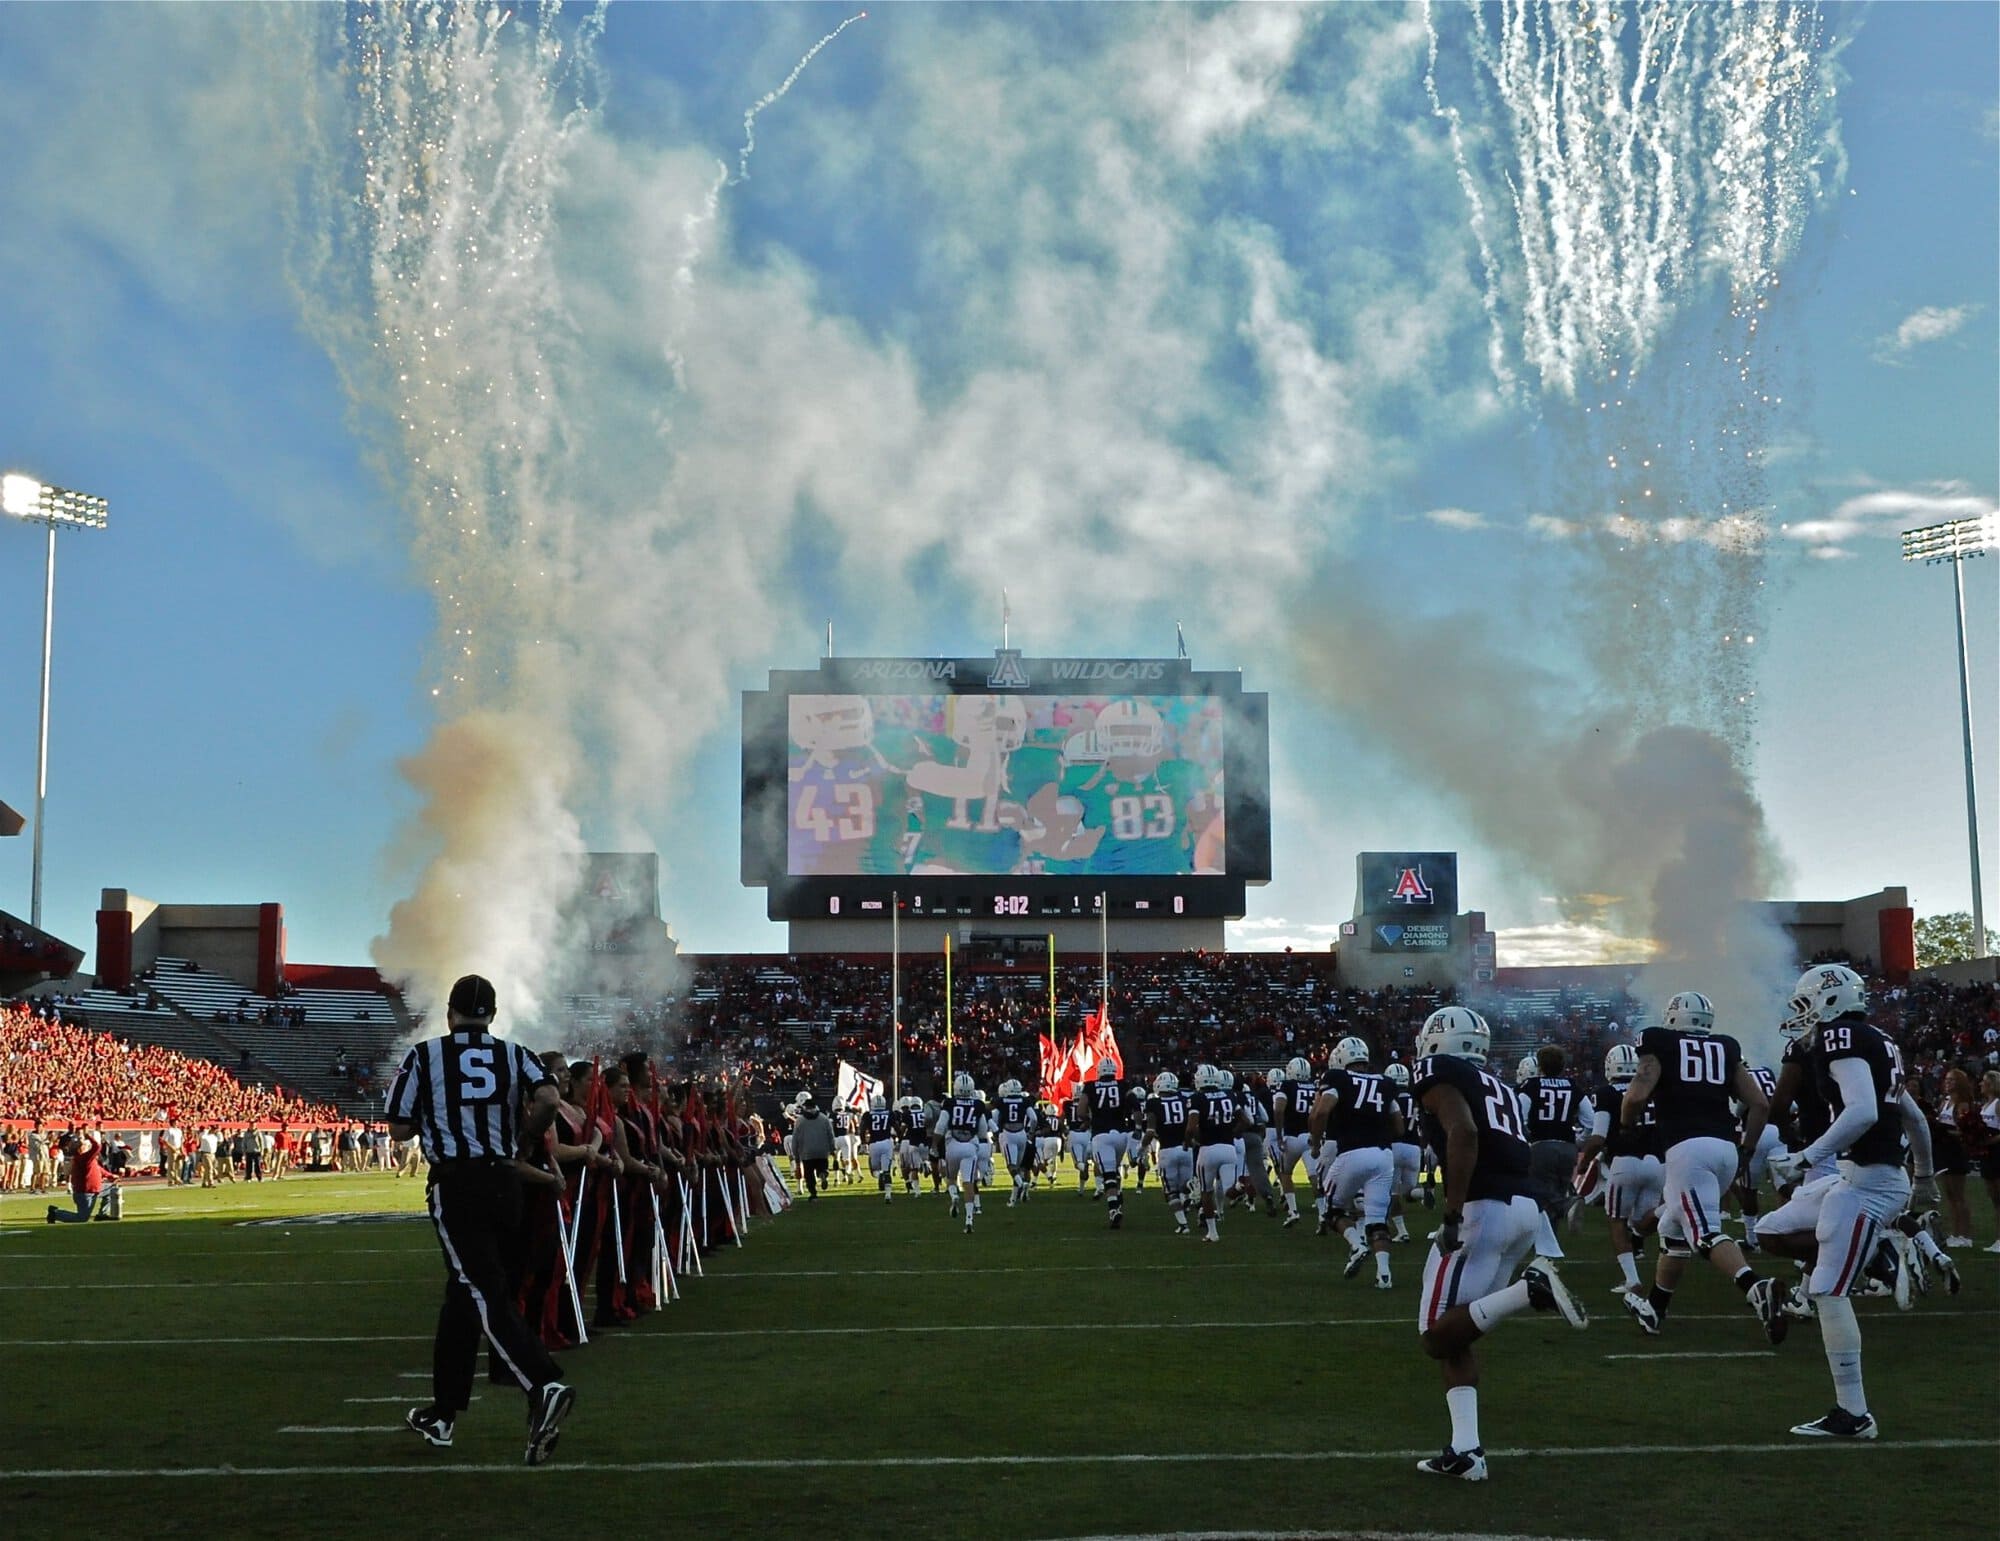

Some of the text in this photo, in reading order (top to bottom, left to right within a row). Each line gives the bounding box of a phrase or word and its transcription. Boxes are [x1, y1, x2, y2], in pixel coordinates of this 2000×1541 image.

[853, 661, 957, 680] ARIZONA
[1051, 662, 1165, 680] WILDCATS
[796, 783, 874, 842] 43
[1111, 795, 1176, 840] 83
[1388, 863, 1434, 904] A
[994, 896, 1029, 915] 3:02
[1820, 970, 1843, 990] A
[1823, 1027, 1852, 1053] 29
[459, 1049, 497, 1099] S
[1412, 1057, 1434, 1084] 21
[1679, 1039, 1726, 1085] 60
[1096, 1086, 1120, 1109] 79
[1352, 1077, 1384, 1113] 74
[1478, 1070, 1530, 1143] 21
[1538, 1088, 1572, 1122] 37
[872, 1114, 889, 1131] 27
[952, 1106, 977, 1128] 84
[1009, 1104, 1018, 1122] 6
[1161, 1101, 1184, 1124] 19
[1207, 1099, 1233, 1125] 48
